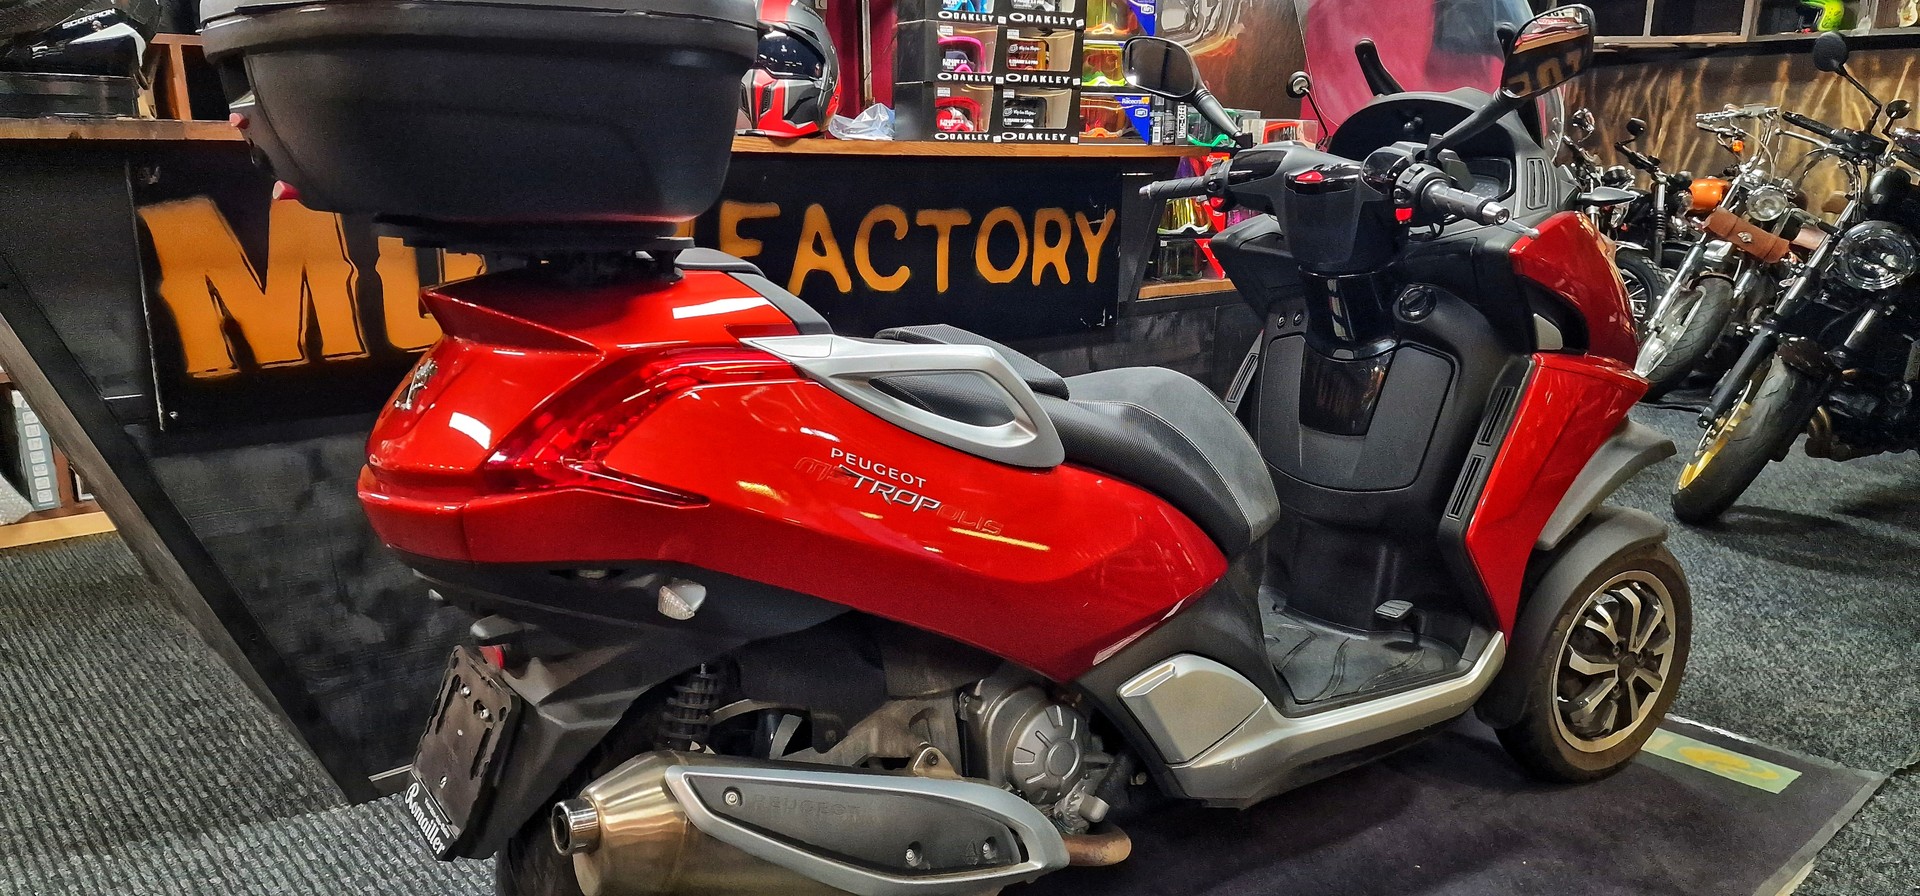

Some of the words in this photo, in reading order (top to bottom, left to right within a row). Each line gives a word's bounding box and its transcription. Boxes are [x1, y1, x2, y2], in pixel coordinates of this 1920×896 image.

[61, 8, 117, 30] SCORPION
[953, 12, 995, 23] OAKLEY
[1027, 15, 1075, 26] OAKLEY
[952, 73, 994, 83] OAKLEY
[1022, 74, 1071, 85] OAKLEY
[949, 132, 990, 141] OAKLEY
[1018, 132, 1067, 141] OAKLEY
[718, 202, 1116, 297] FACTORY
[830, 447, 927, 489] PEUGEOT
[794, 456, 1005, 535] METROPOLIS
[404, 782, 446, 855] Romailler
